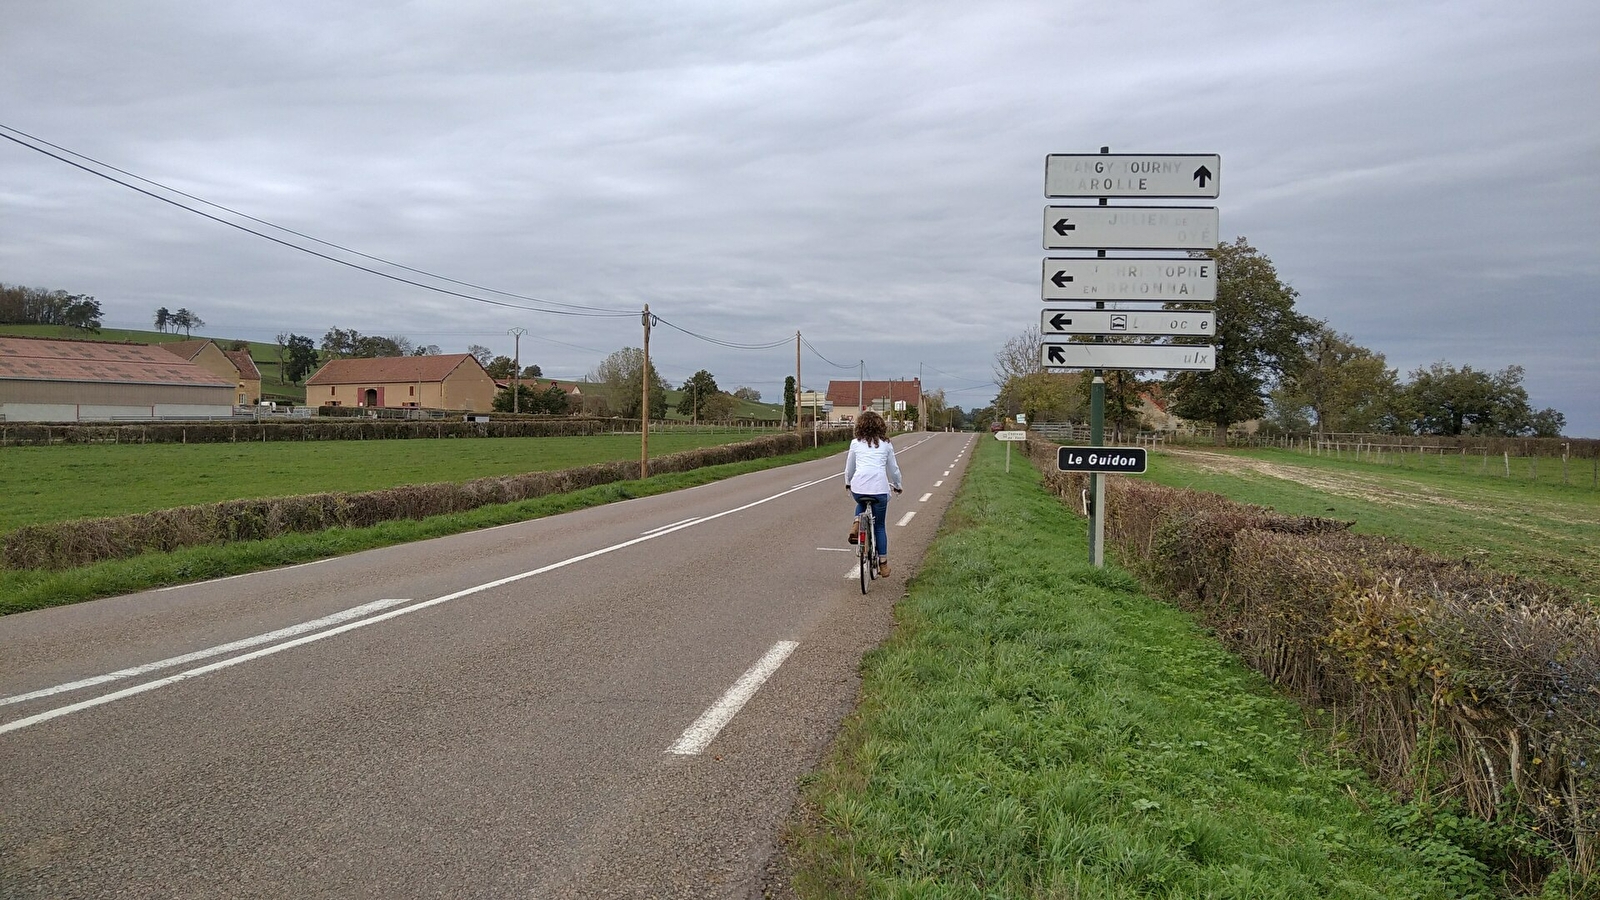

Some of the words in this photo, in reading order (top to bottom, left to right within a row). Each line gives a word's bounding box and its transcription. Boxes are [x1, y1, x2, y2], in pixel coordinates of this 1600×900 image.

[1083, 285, 1098, 294] EN
[1068, 453, 1083, 465] Le
[1088, 453, 1136, 466] Guidon
